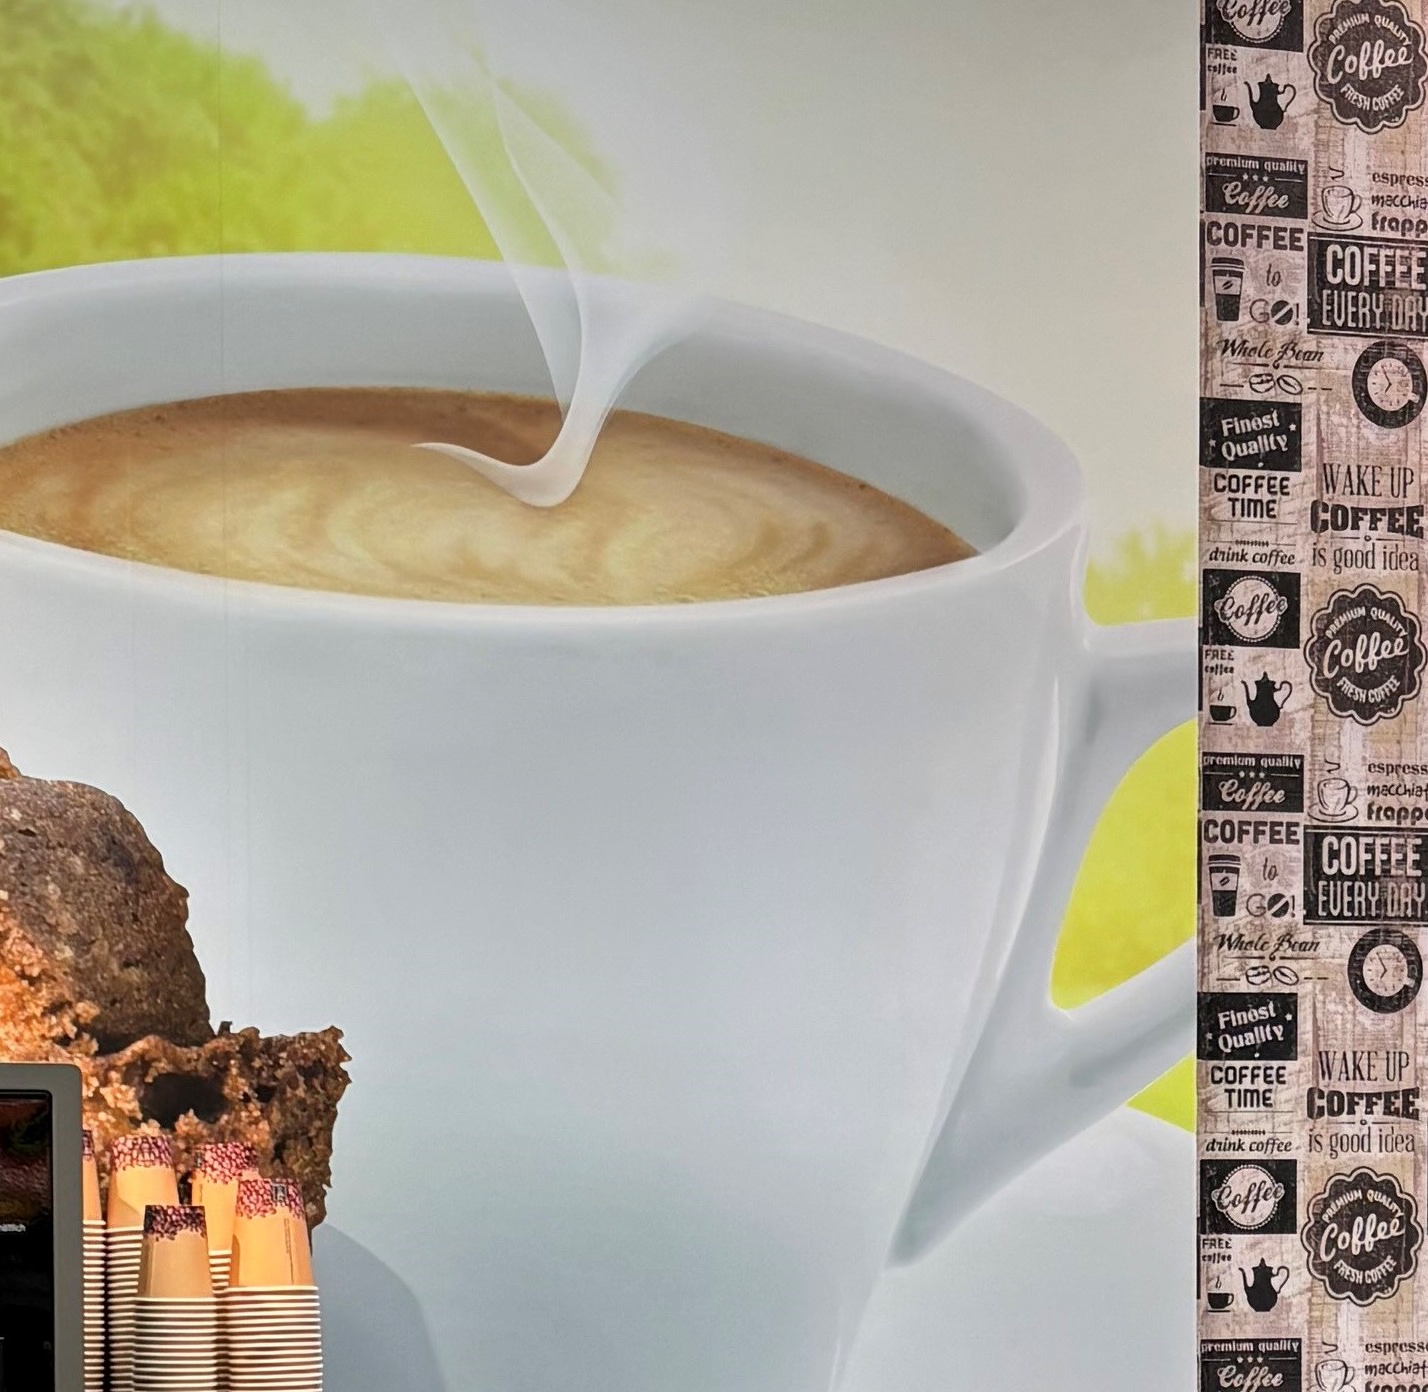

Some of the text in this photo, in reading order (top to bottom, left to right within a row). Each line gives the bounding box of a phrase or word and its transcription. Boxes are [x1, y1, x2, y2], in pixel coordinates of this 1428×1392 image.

[1329, 13, 1412, 48] PREMIUM QUALITY
[1208, 49, 1237, 61] FREE
[1327, 39, 1414, 84] Coffee
[1340, 83, 1405, 111] FRESH COFFEE
[1207, 158, 1304, 174] premium quality
[1223, 181, 1288, 212] Coffee
[1207, 221, 1304, 251] COFFEE
[1326, 245, 1426, 290] COFFEE
[1323, 289, 1381, 329] EVERY
[1216, 339, 1272, 359] Whole
[1221, 411, 1280, 438] Finest
[1222, 432, 1288, 461] Quality
[1214, 474, 1290, 496] COFFEE
[1322, 463, 1415, 499] WAKE UP
[1227, 497, 1277, 519] TIME
[1311, 500, 1424, 538] COFFEE
[1208, 546, 1295, 567] drink coffee
[1312, 542, 1419, 574] is good idea
[1217, 593, 1287, 626] Coffee
[1325, 607, 1408, 639] PREMIUM QUALITY
[1323, 632, 1409, 679] Coffee
[1337, 676, 1401, 704] FRESH COFFEE
[1204, 819, 1300, 845] COFFEE
[1322, 835, 1422, 876] COFFEE
[1318, 881, 1426, 918] EVERY DAY
